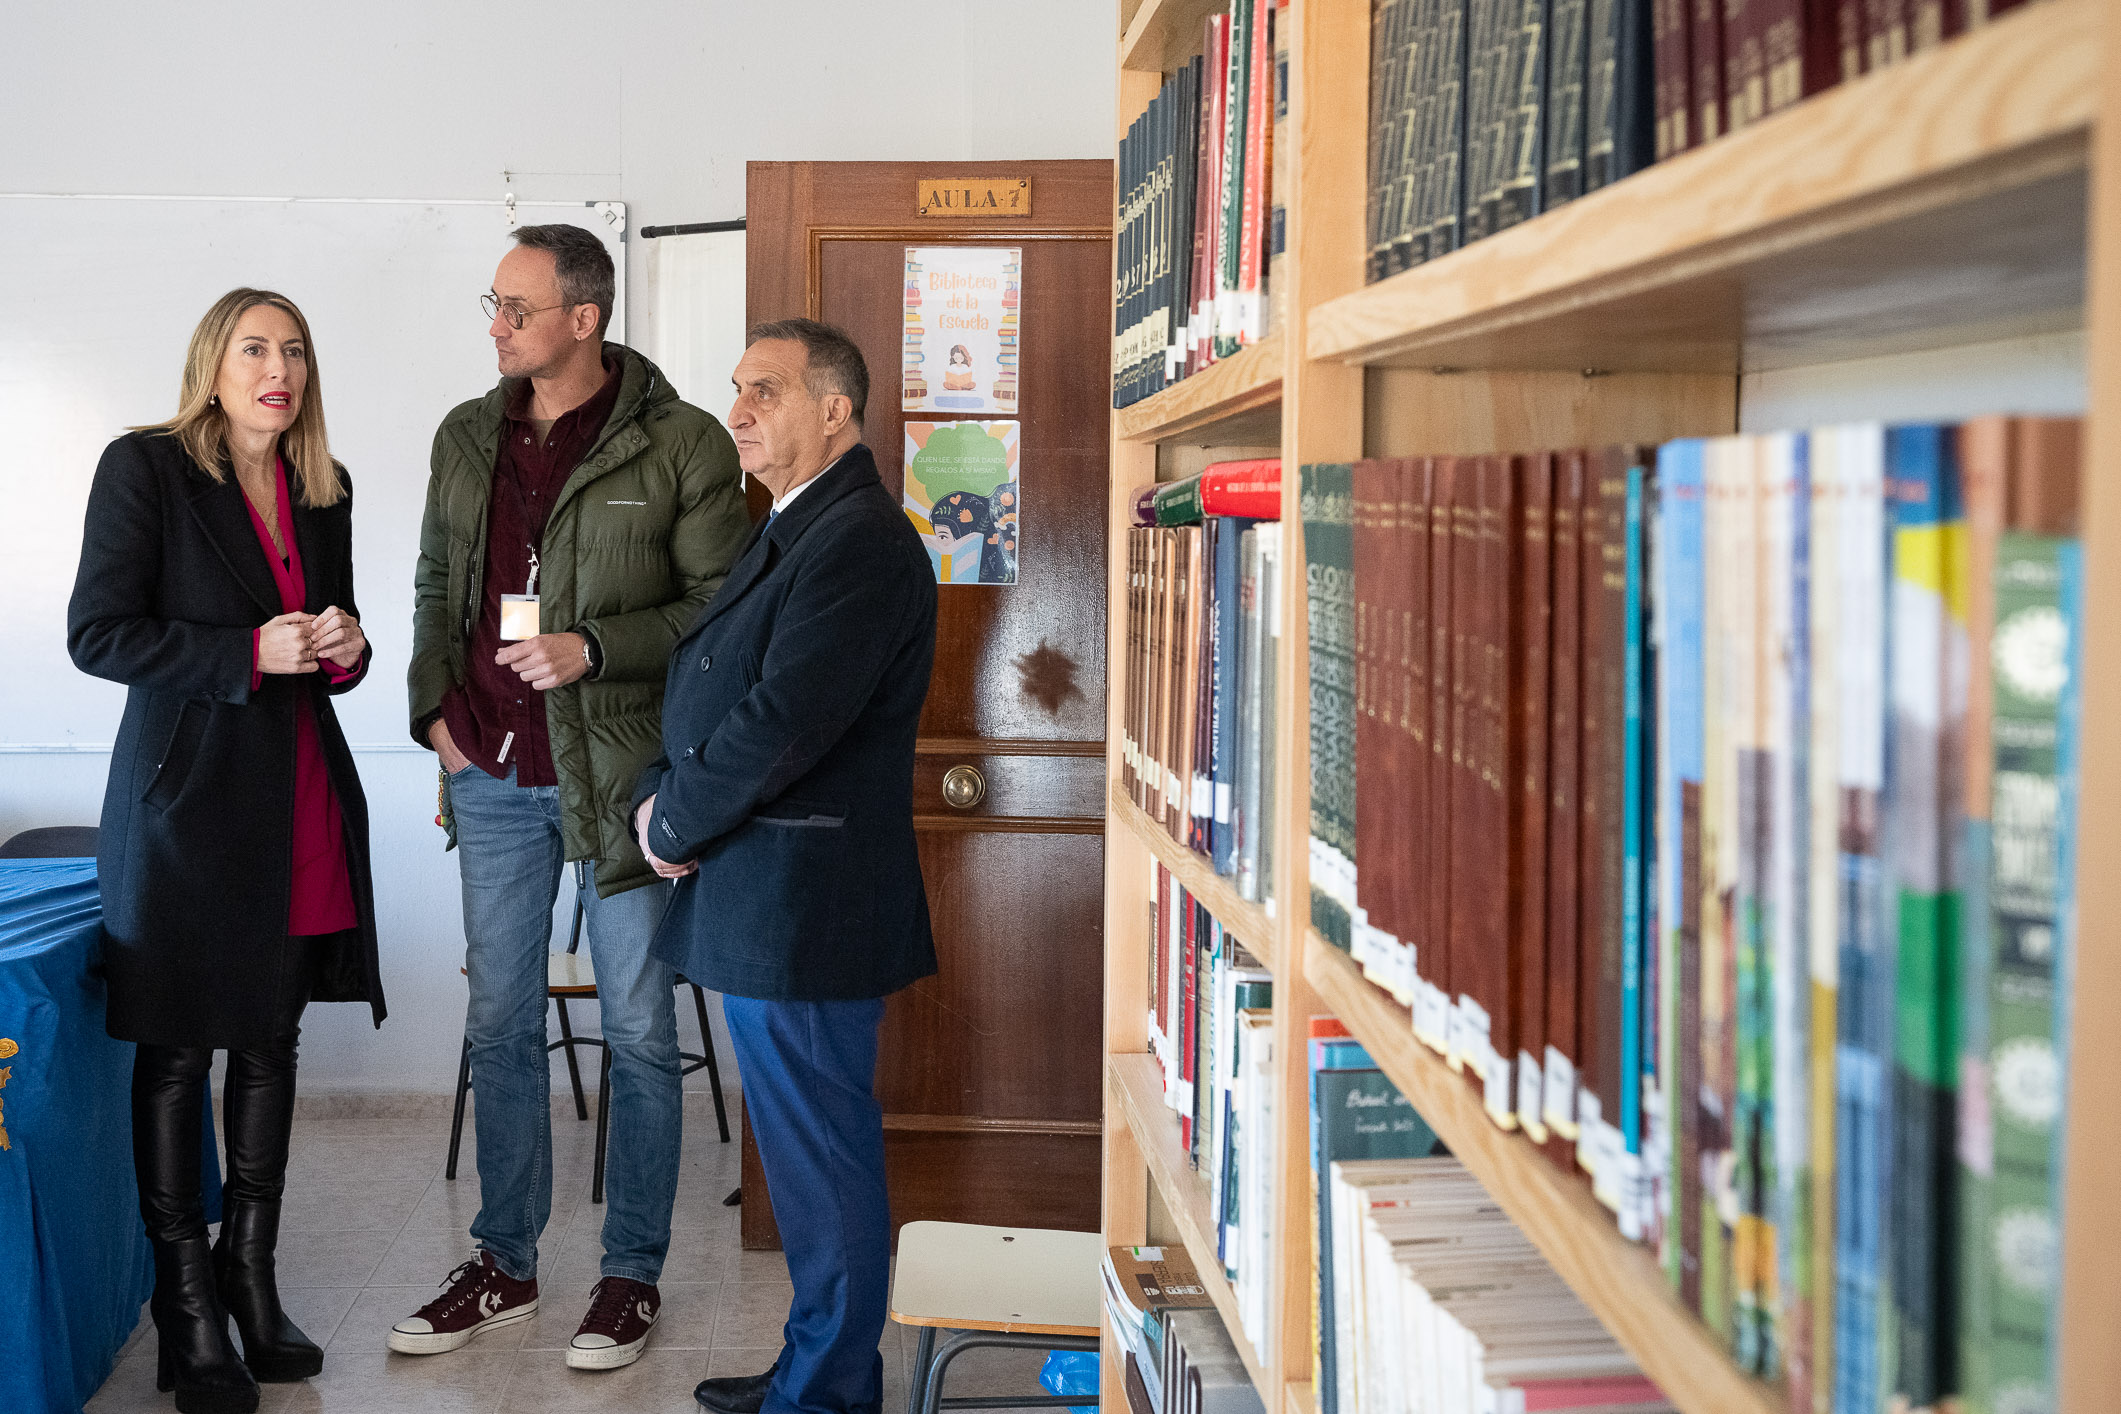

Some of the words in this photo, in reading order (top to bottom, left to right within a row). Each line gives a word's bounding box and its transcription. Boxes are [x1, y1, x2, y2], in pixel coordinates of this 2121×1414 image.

[929, 271, 997, 290] Biblioteca
[946, 292, 963, 309] de
[965, 292, 979, 310] la
[939, 313, 989, 330] Escuela
